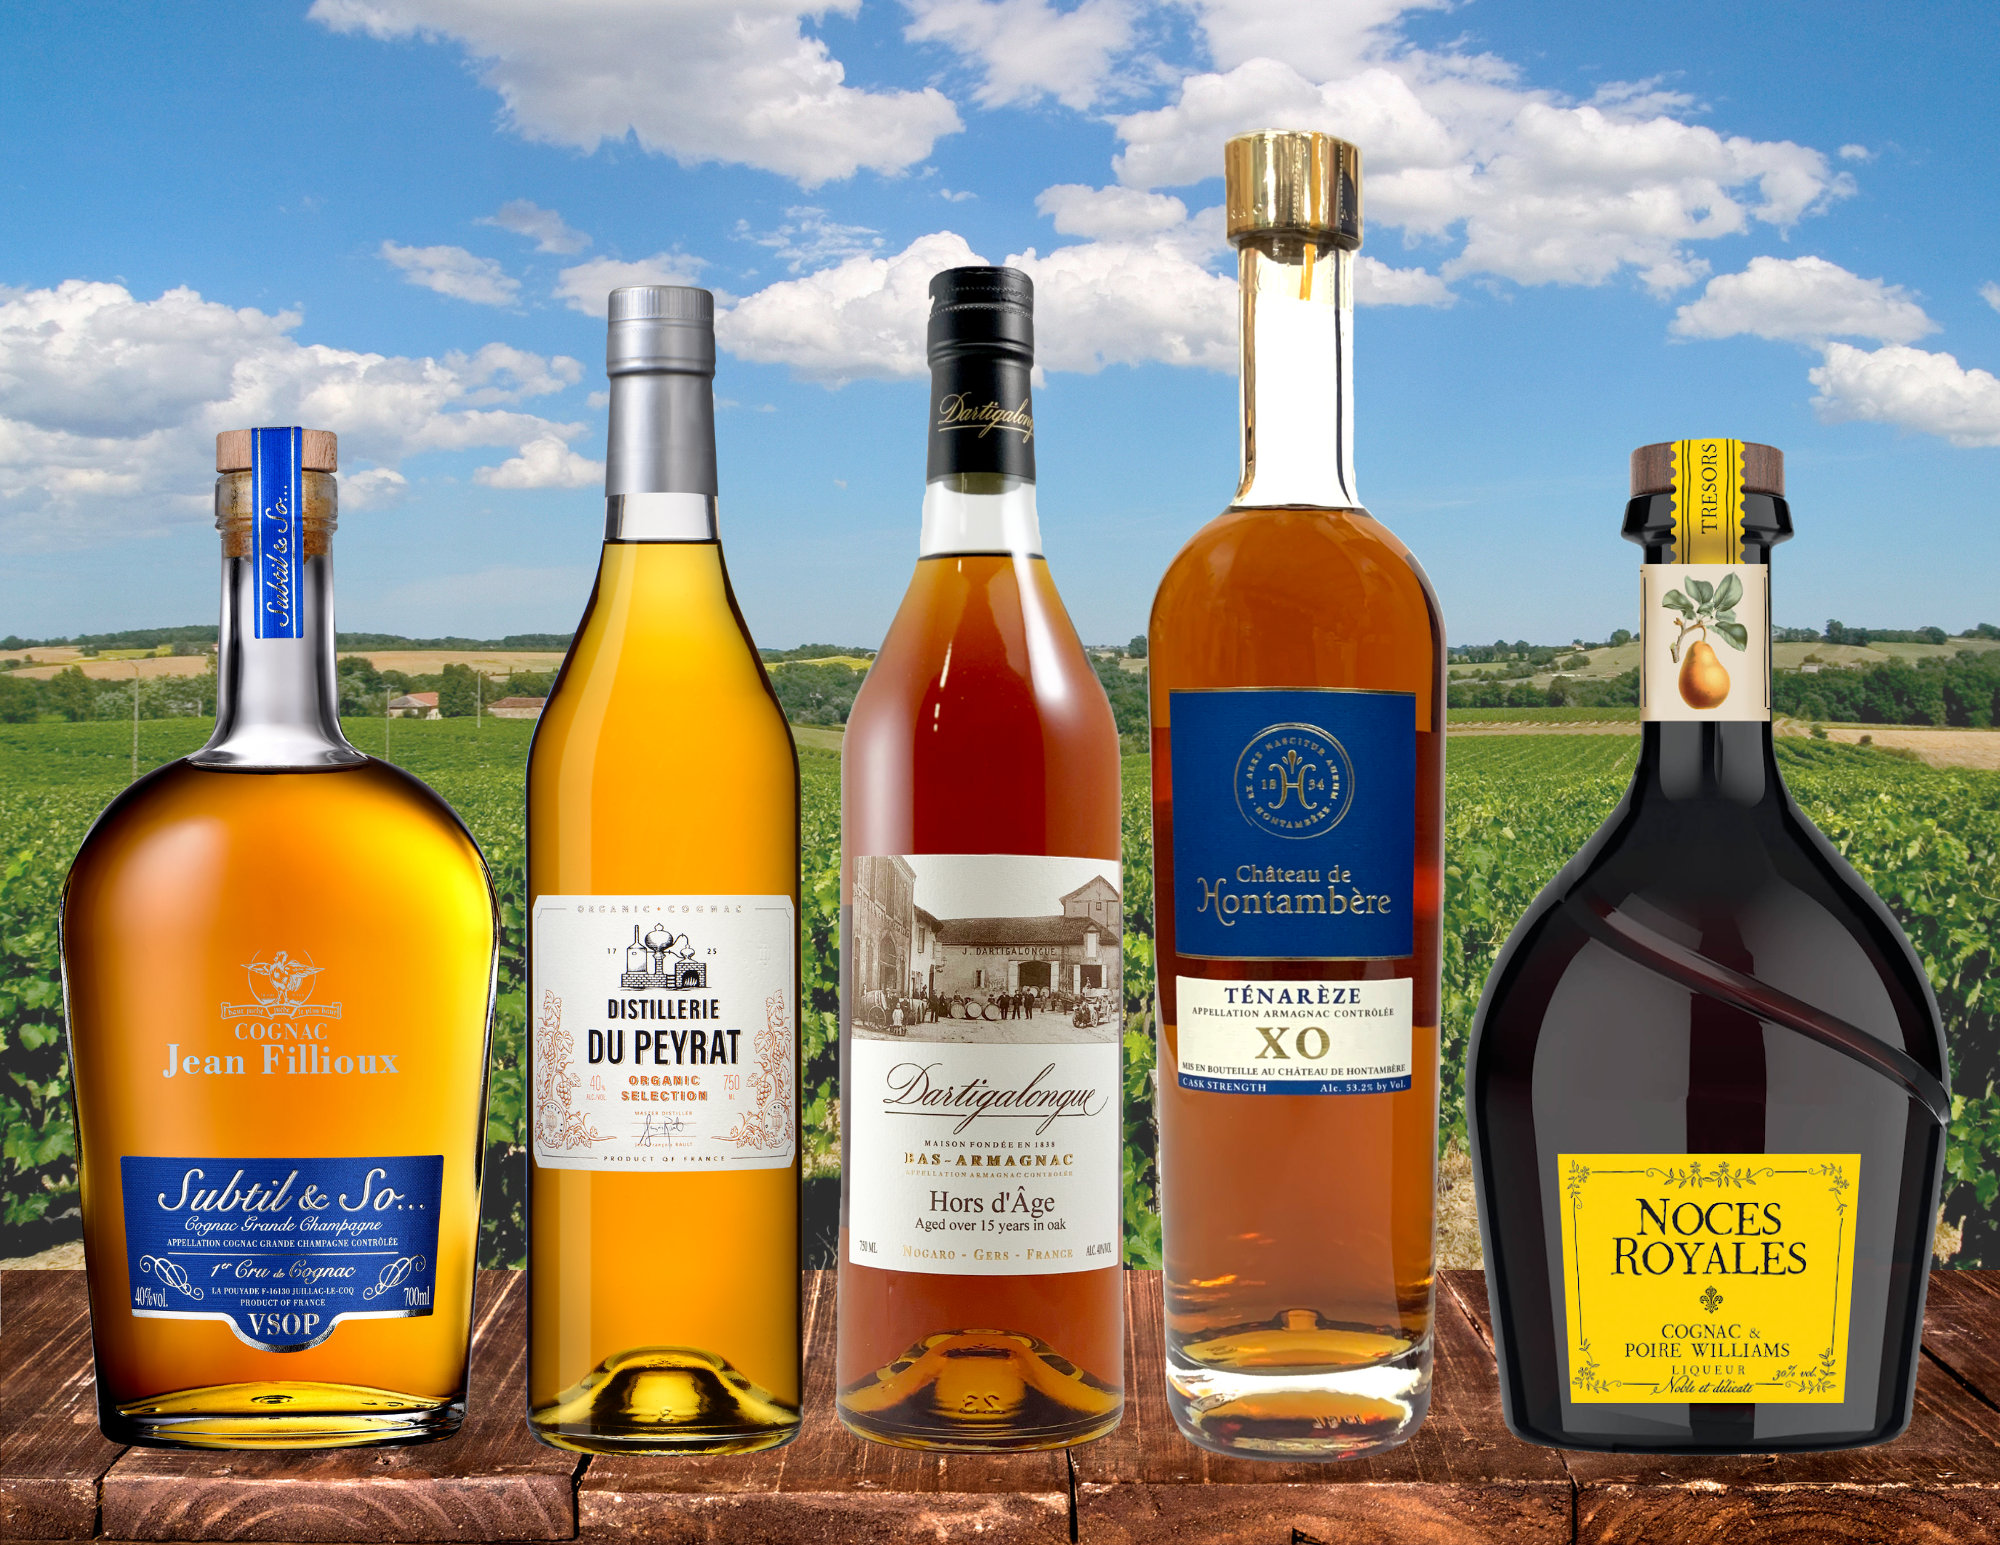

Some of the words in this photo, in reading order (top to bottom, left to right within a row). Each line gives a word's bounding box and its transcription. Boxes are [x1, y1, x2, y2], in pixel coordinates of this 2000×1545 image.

[1701, 443, 1717, 534] TRESORS
[266, 485, 288, 533] So...
[274, 537, 288, 553] &
[266, 553, 289, 627] Subtil
[1308, 778, 1324, 790] 34
[1236, 865, 1320, 882] Château
[1328, 865, 1351, 882] de
[668, 905, 742, 914] COGNAC
[1197, 878, 1391, 926] Hontambère
[1224, 984, 1361, 1004] TÉNARÈZE
[608, 999, 720, 1020] DISTILLERIE
[1192, 1007, 1259, 1017] APPELLATION
[1263, 1009, 1330, 1018] ARMAGNAC
[1334, 1007, 1394, 1017] CONTRÔLÉE
[235, 1023, 328, 1040] COGNAC
[588, 1030, 625, 1065] DU
[635, 1030, 742, 1065] PEYRAT
[1254, 1026, 1330, 1060] XO
[162, 1044, 246, 1078] Jean
[261, 1044, 399, 1074] Fillioux
[1182, 1062, 1194, 1071] MIS
[1195, 1063, 1205, 1072] EN
[1208, 1065, 1258, 1075] BOUTEILLE
[1278, 1066, 1328, 1076] CHÂTEAU
[1347, 1063, 1405, 1075] HONTAMBÈRE
[628, 1076, 700, 1086] ORGANIC
[723, 1074, 740, 1091] 750
[1183, 1078, 1204, 1089] CASK
[1208, 1081, 1266, 1092] STRENGTH
[1320, 1084, 1341, 1092] Alc.
[1346, 1083, 1373, 1092] 53.2%
[1377, 1082, 1387, 1092] by
[1390, 1080, 1406, 1088] Vol.
[621, 1091, 708, 1101] SELECTION
[883, 1063, 1109, 1135] Dartigalongue
[905, 1152, 1073, 1166] BAS-ARMAGNAC
[157, 1168, 299, 1212] Subtil
[298, 1184, 330, 1211] &
[338, 1168, 426, 1211] So...
[930, 1190, 983, 1213] Hors
[991, 1186, 1055, 1218] d'Âge
[184, 1216, 239, 1236] Cognac
[241, 1214, 296, 1232] Grande
[299, 1216, 382, 1236] Champagne
[1635, 1198, 1782, 1236] NOCES
[915, 1218, 946, 1232] Aged
[949, 1221, 976, 1231] over
[981, 1220, 994, 1231] 15
[998, 1221, 1029, 1234] years
[1033, 1220, 1044, 1231] in
[1047, 1218, 1067, 1230] oak
[167, 1238, 220, 1247] APPELLATION
[223, 1239, 258, 1248] COGNAC
[259, 1239, 295, 1248] GRANDE
[297, 1238, 349, 1248] CHAMPAGNE
[351, 1237, 398, 1247] CONTRÔLÉE
[869, 1242, 878, 1253] ML
[1610, 1237, 1807, 1275] ROYALES
[210, 1262, 232, 1278] 1er
[235, 1259, 270, 1279] Cru
[273, 1270, 286, 1279] de
[289, 1259, 356, 1284] Cognac
[135, 1287, 169, 1308] 40%vol.
[292, 1286, 354, 1296] JUILLAC-LE-COQ
[403, 1286, 430, 1306] 700ml
[240, 1298, 279, 1307] PRODUCT
[294, 1298, 326, 1307] FRANCE
[248, 1312, 320, 1336] VSOP
[1661, 1324, 1741, 1339] COGNAC
[1749, 1327, 1761, 1339] &
[1625, 1343, 1681, 1358] POIRE
[1692, 1343, 1790, 1358] WILLIAMS
[1672, 1365, 1746, 1376] LIQUEUR
[1772, 1364, 1798, 1380] 30%
[1800, 1366, 1817, 1379] vol.
[1650, 1375, 1696, 1396] Noble
[1698, 1382, 1711, 1393] et
[1713, 1379, 1755, 1393] délicate
